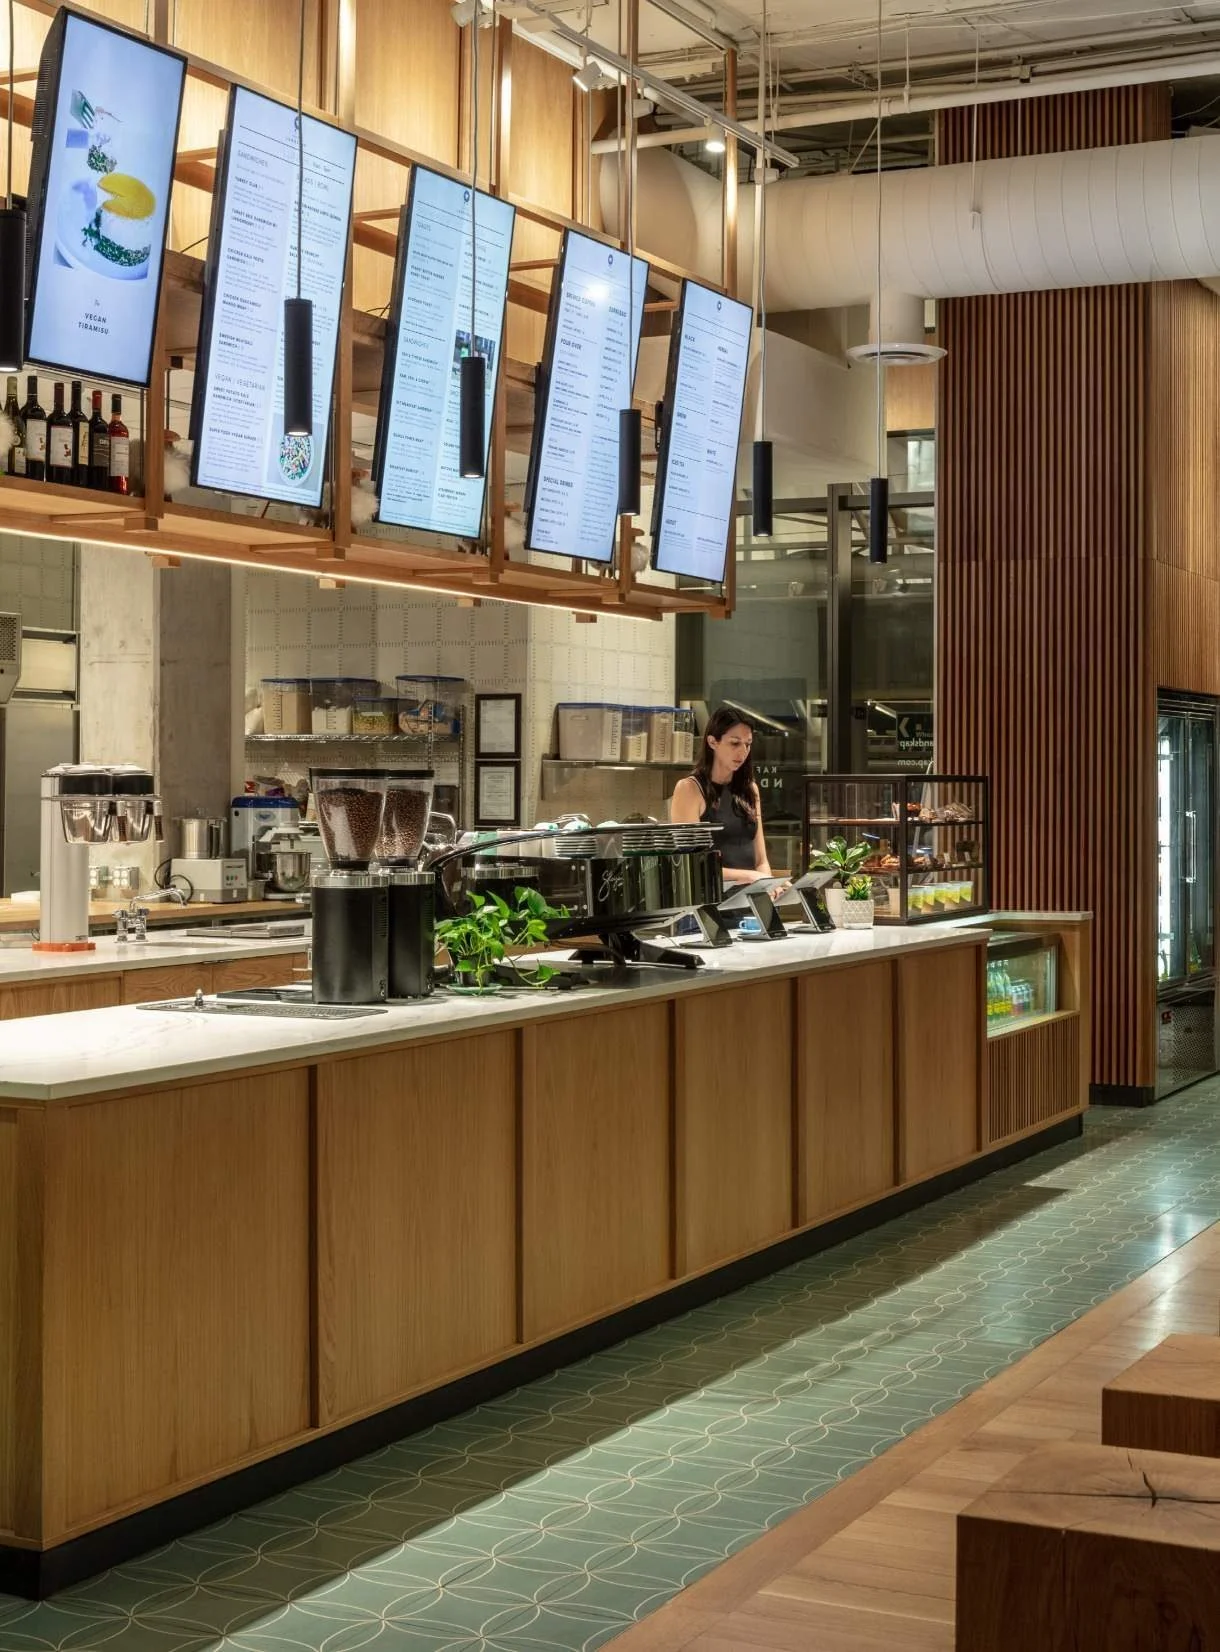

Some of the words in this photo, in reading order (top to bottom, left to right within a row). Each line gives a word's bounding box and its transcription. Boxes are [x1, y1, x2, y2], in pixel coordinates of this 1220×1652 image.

[85, 313, 107, 323] VEGAN
[78, 321, 109, 335] TIRAMISU
[560, 337, 571, 347] POUR
[543, 475, 559, 485] SPECIAL
